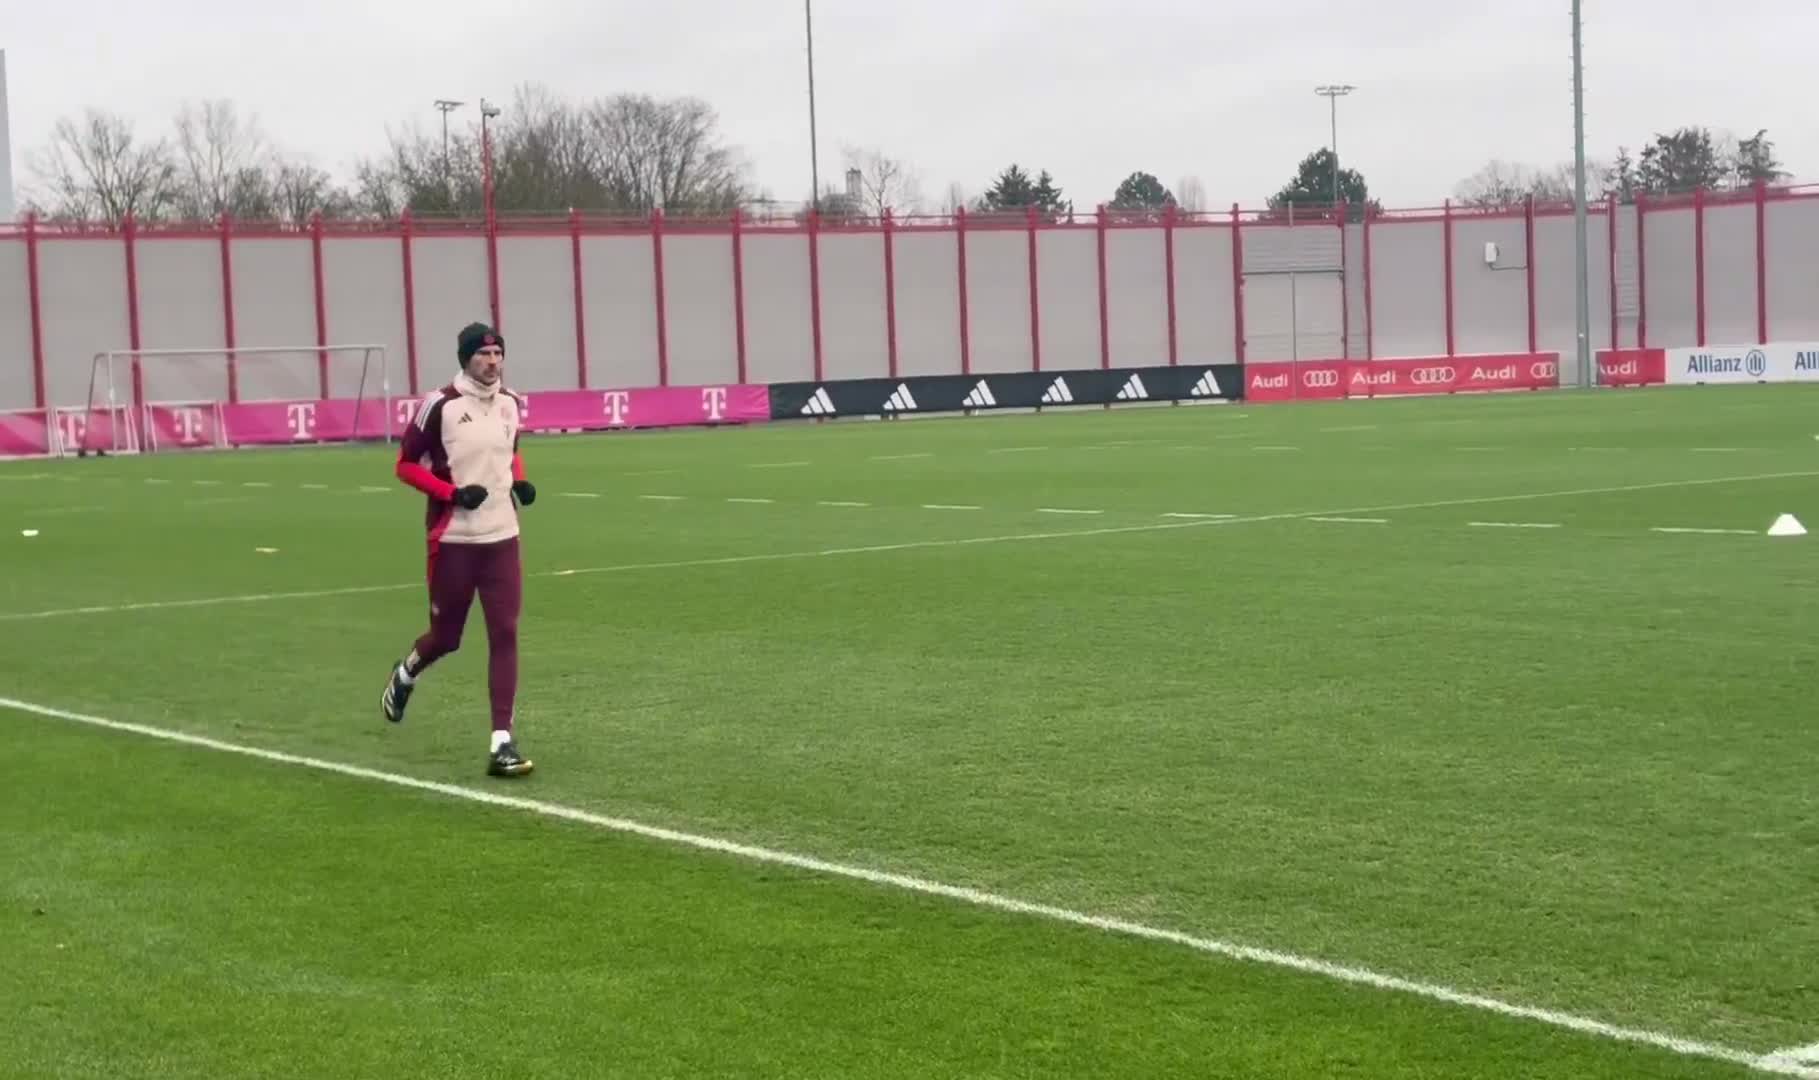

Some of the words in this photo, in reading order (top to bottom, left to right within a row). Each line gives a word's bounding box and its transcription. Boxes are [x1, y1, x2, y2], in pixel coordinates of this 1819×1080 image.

[1688, 354, 1741, 373] Allianz
[1794, 351, 1819, 370] All
[1251, 374, 1288, 388] Audi
[1351, 370, 1396, 385] Audi
[1471, 366, 1516, 380] Audi
[603, 391, 629, 424] T
[703, 387, 727, 420] T
[287, 403, 316, 439] T
